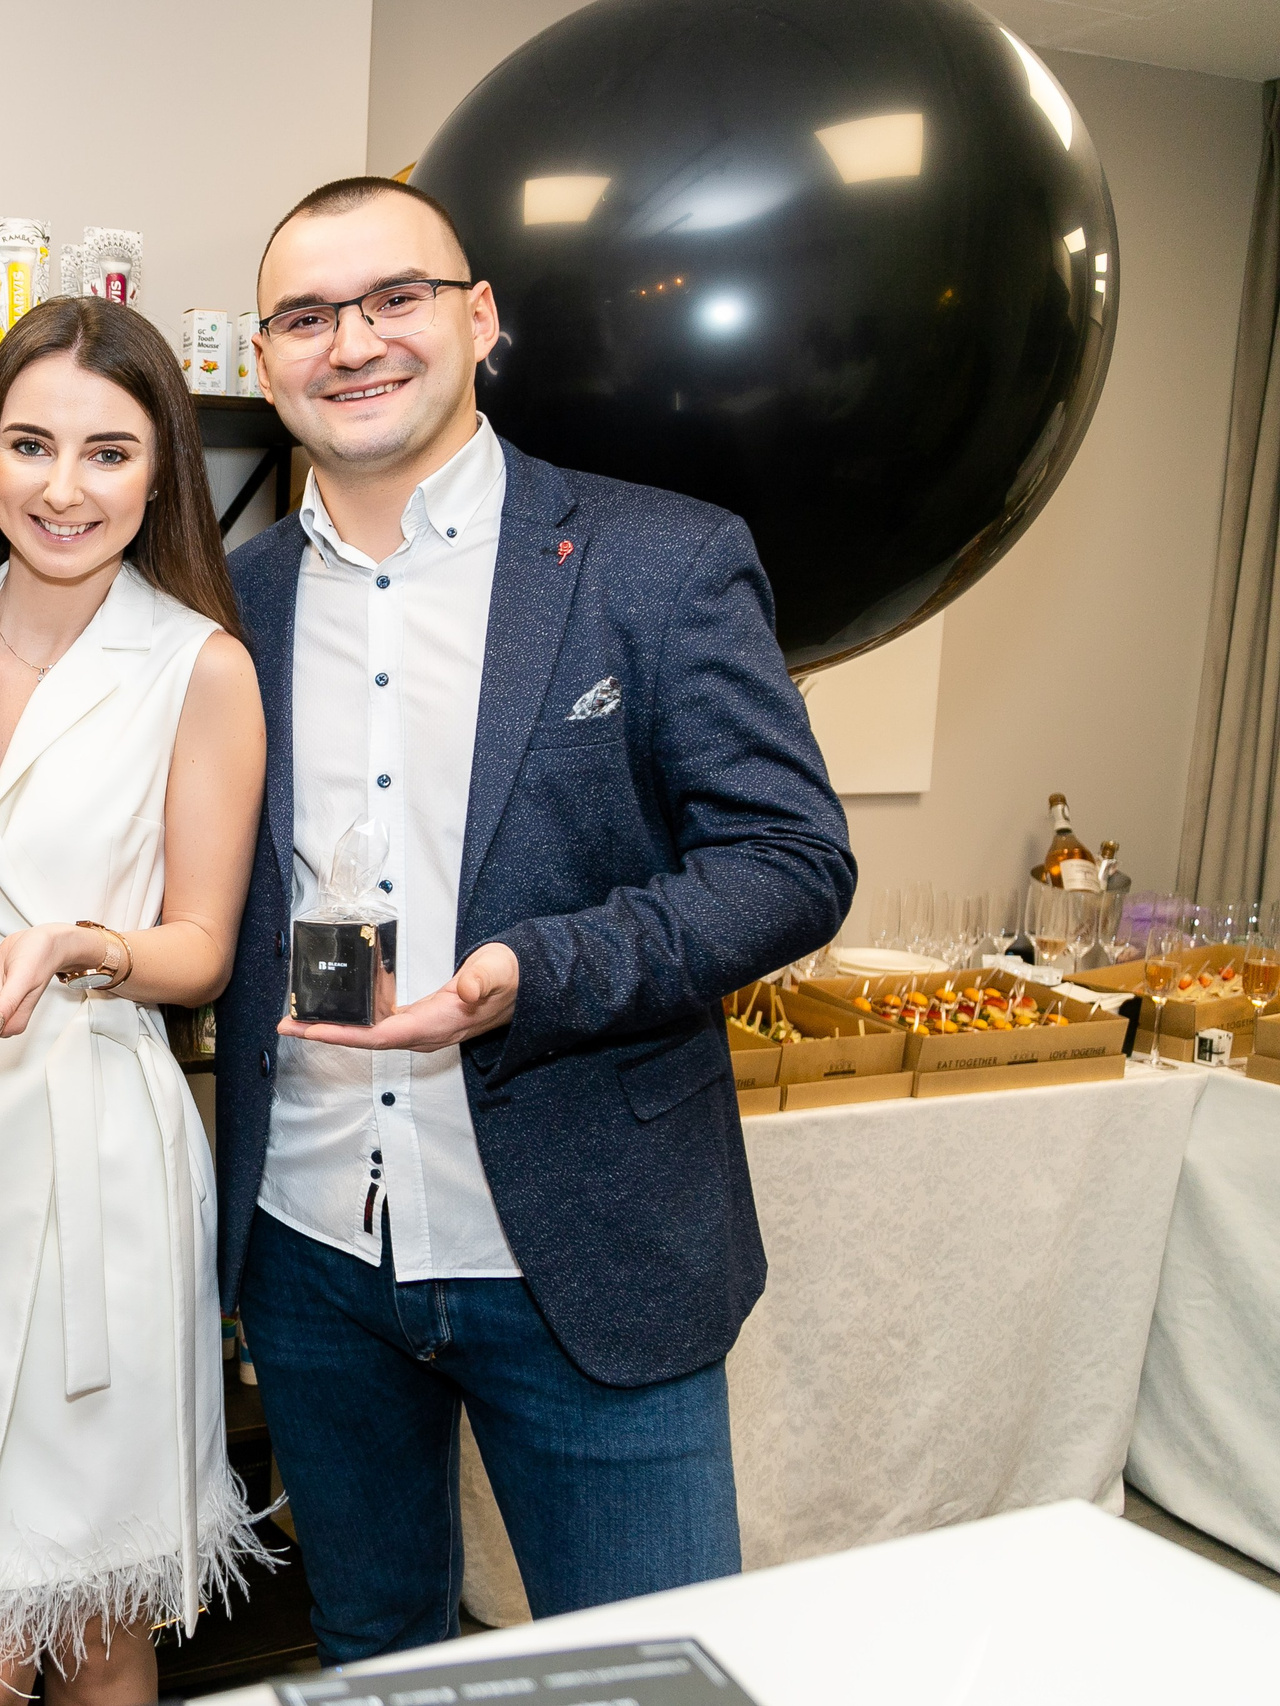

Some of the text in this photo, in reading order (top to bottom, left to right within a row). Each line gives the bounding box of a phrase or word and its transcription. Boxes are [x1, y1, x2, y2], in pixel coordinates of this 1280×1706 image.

[98, 242, 133, 254] KARAKUM
[111, 281, 122, 303] VIS
[1049, 1050, 1068, 1060] LOVE
[1070, 1046, 1107, 1058] TOGETHER
[936, 1060, 953, 1070] EAT
[955, 1057, 998, 1069] TOGETHER
[736, 1077, 756, 1088] THER
